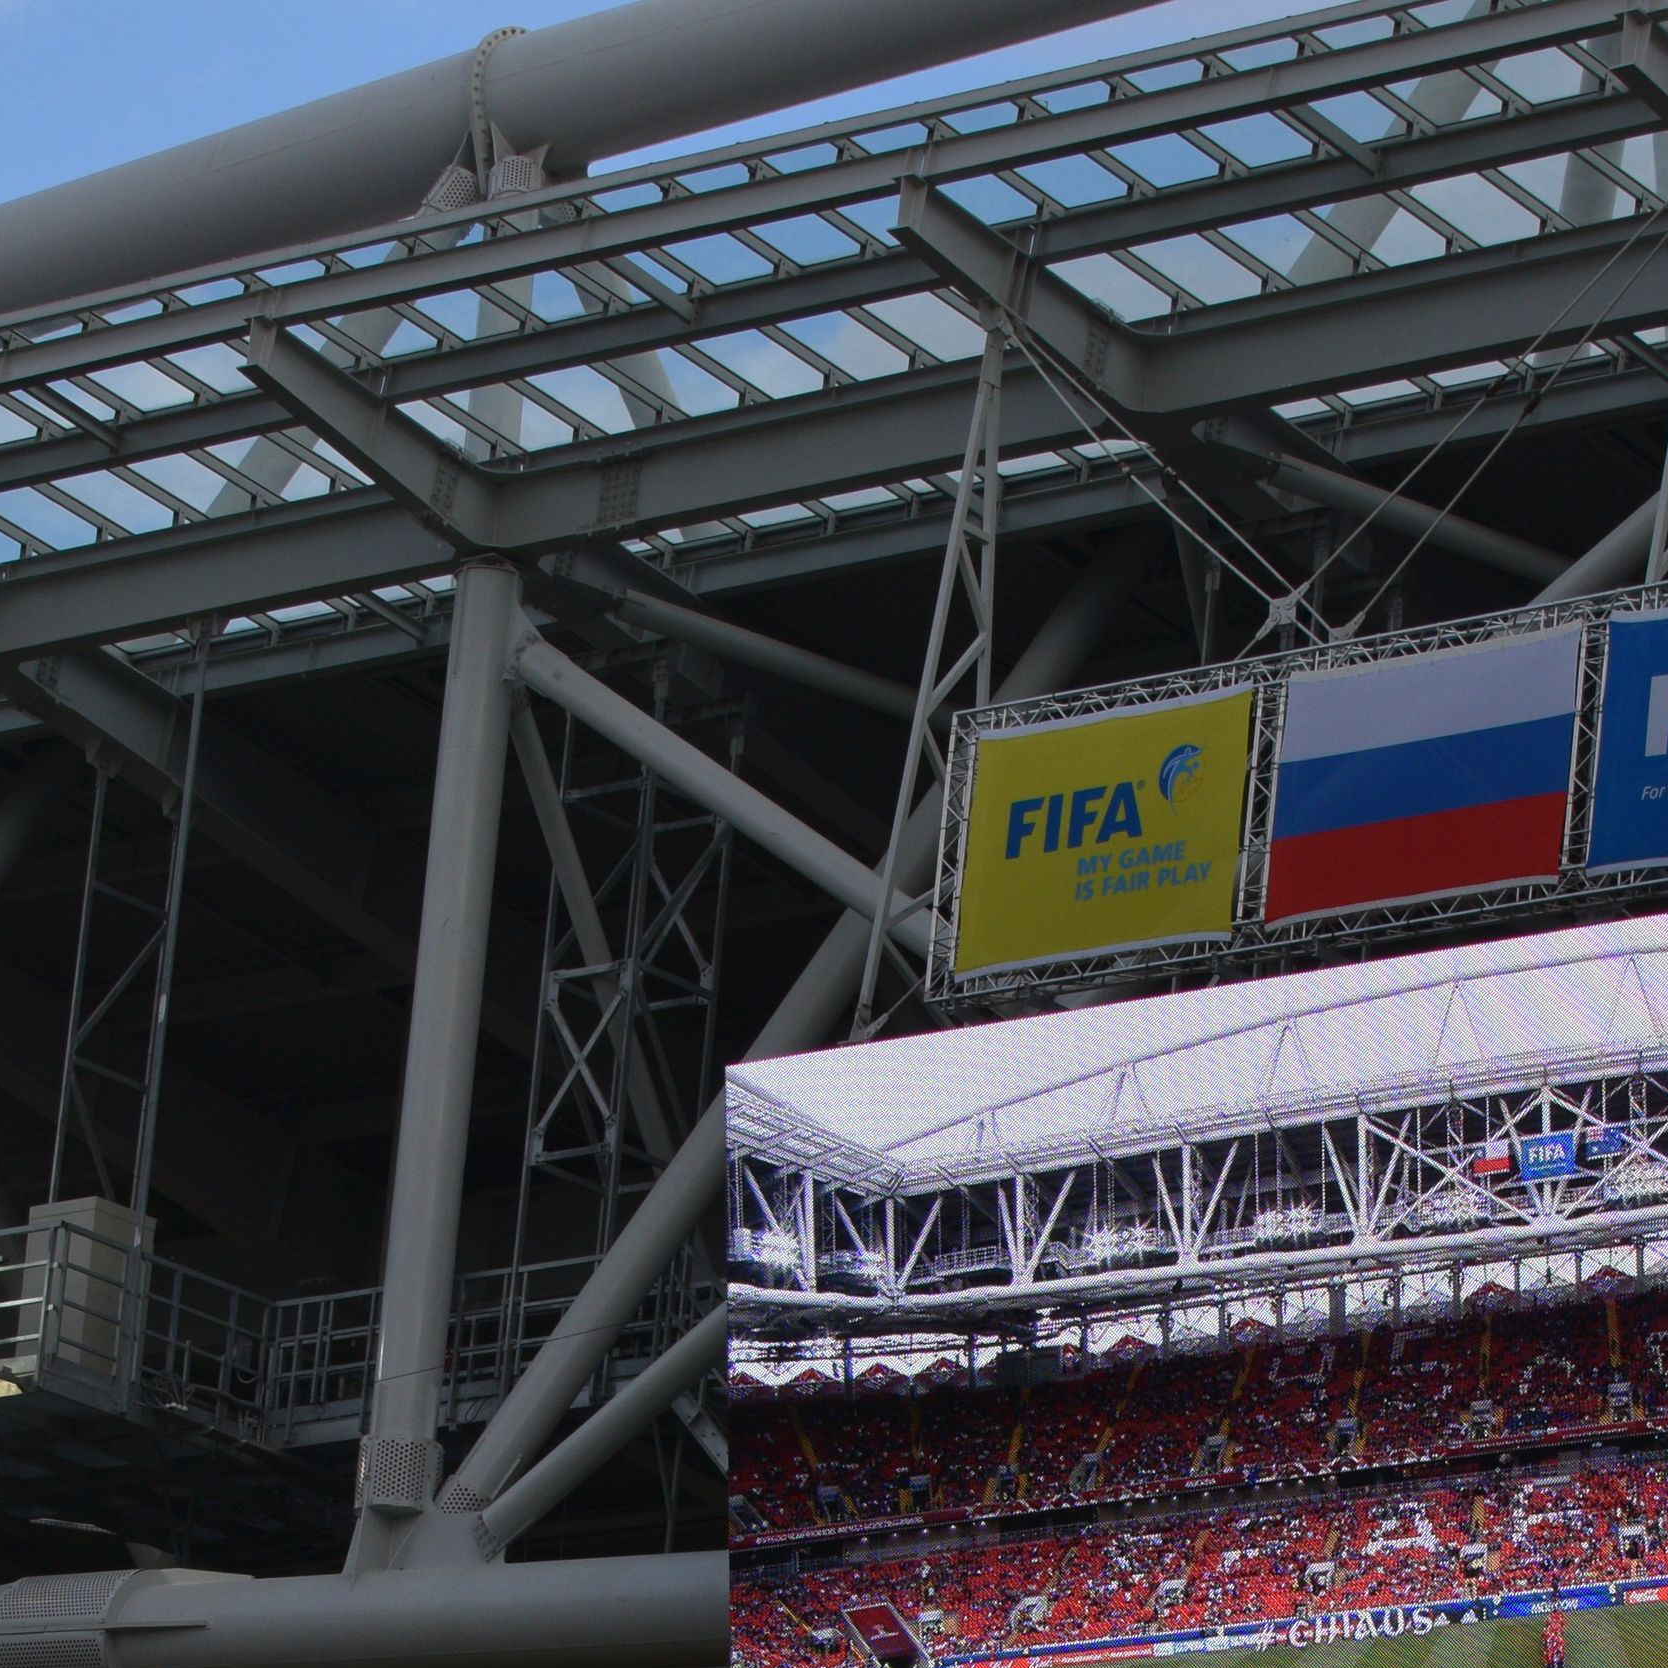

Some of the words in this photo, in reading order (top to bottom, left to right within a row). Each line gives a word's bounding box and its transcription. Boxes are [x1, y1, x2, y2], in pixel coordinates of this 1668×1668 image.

[1641, 785, 1666, 800] For
[1005, 781, 1143, 860] FIFA
[1076, 853, 1112, 877] MY
[1118, 840, 1187, 870] GAME
[1074, 879, 1095, 902] IS
[1101, 870, 1150, 897] FAIR
[1156, 861, 1213, 887] PLAY
[1529, 1143, 1566, 1164] FIFA
